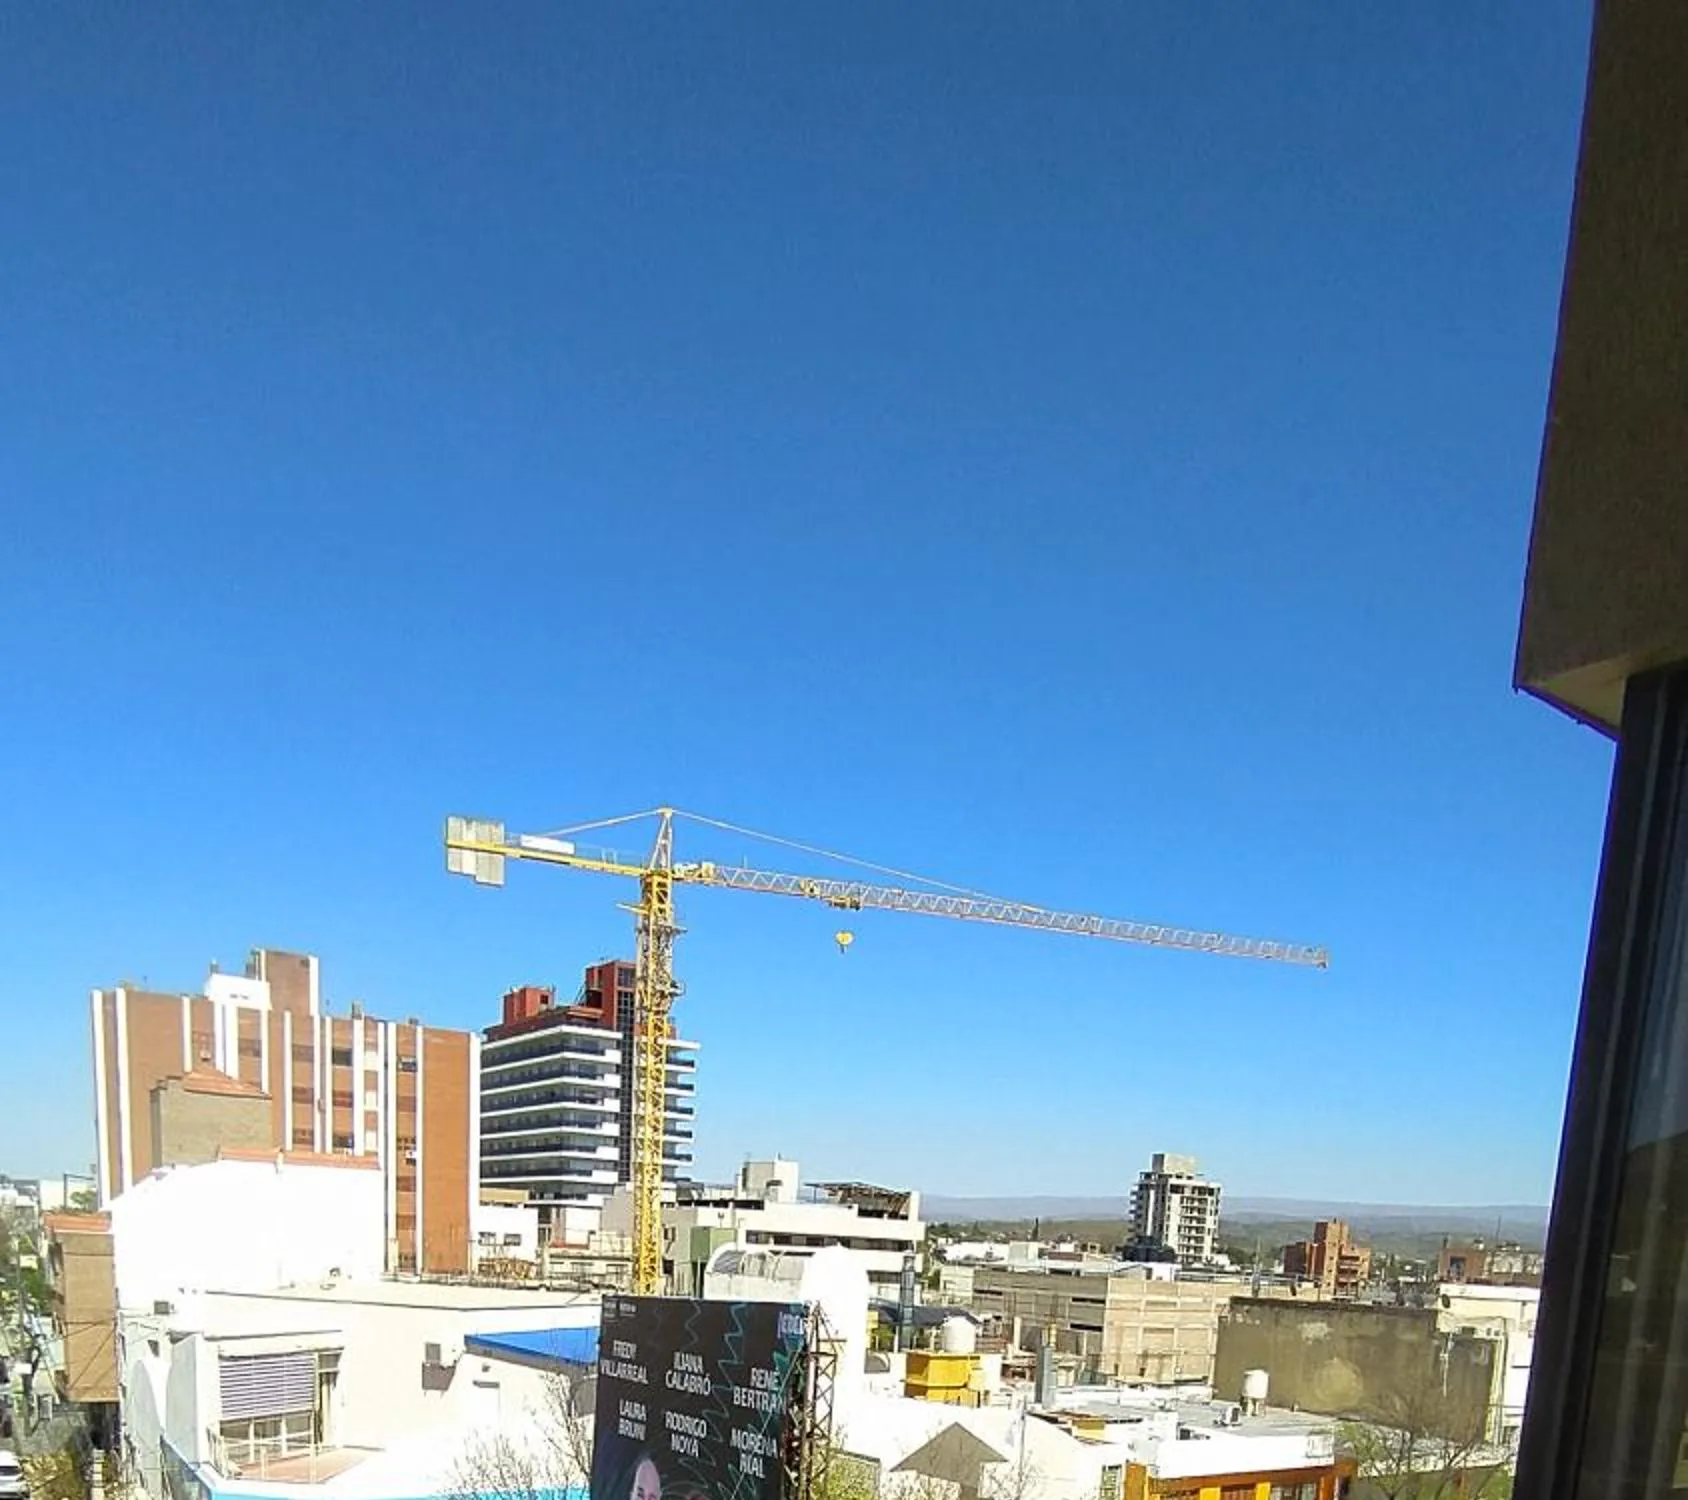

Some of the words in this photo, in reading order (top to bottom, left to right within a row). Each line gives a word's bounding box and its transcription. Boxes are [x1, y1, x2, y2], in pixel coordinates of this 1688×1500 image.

[601, 1358, 648, 1384] VILLARREAL
[619, 1399, 647, 1421] LAURA
[665, 1411, 707, 1438] RODRIGO
[671, 1433, 699, 1457] NOYA
